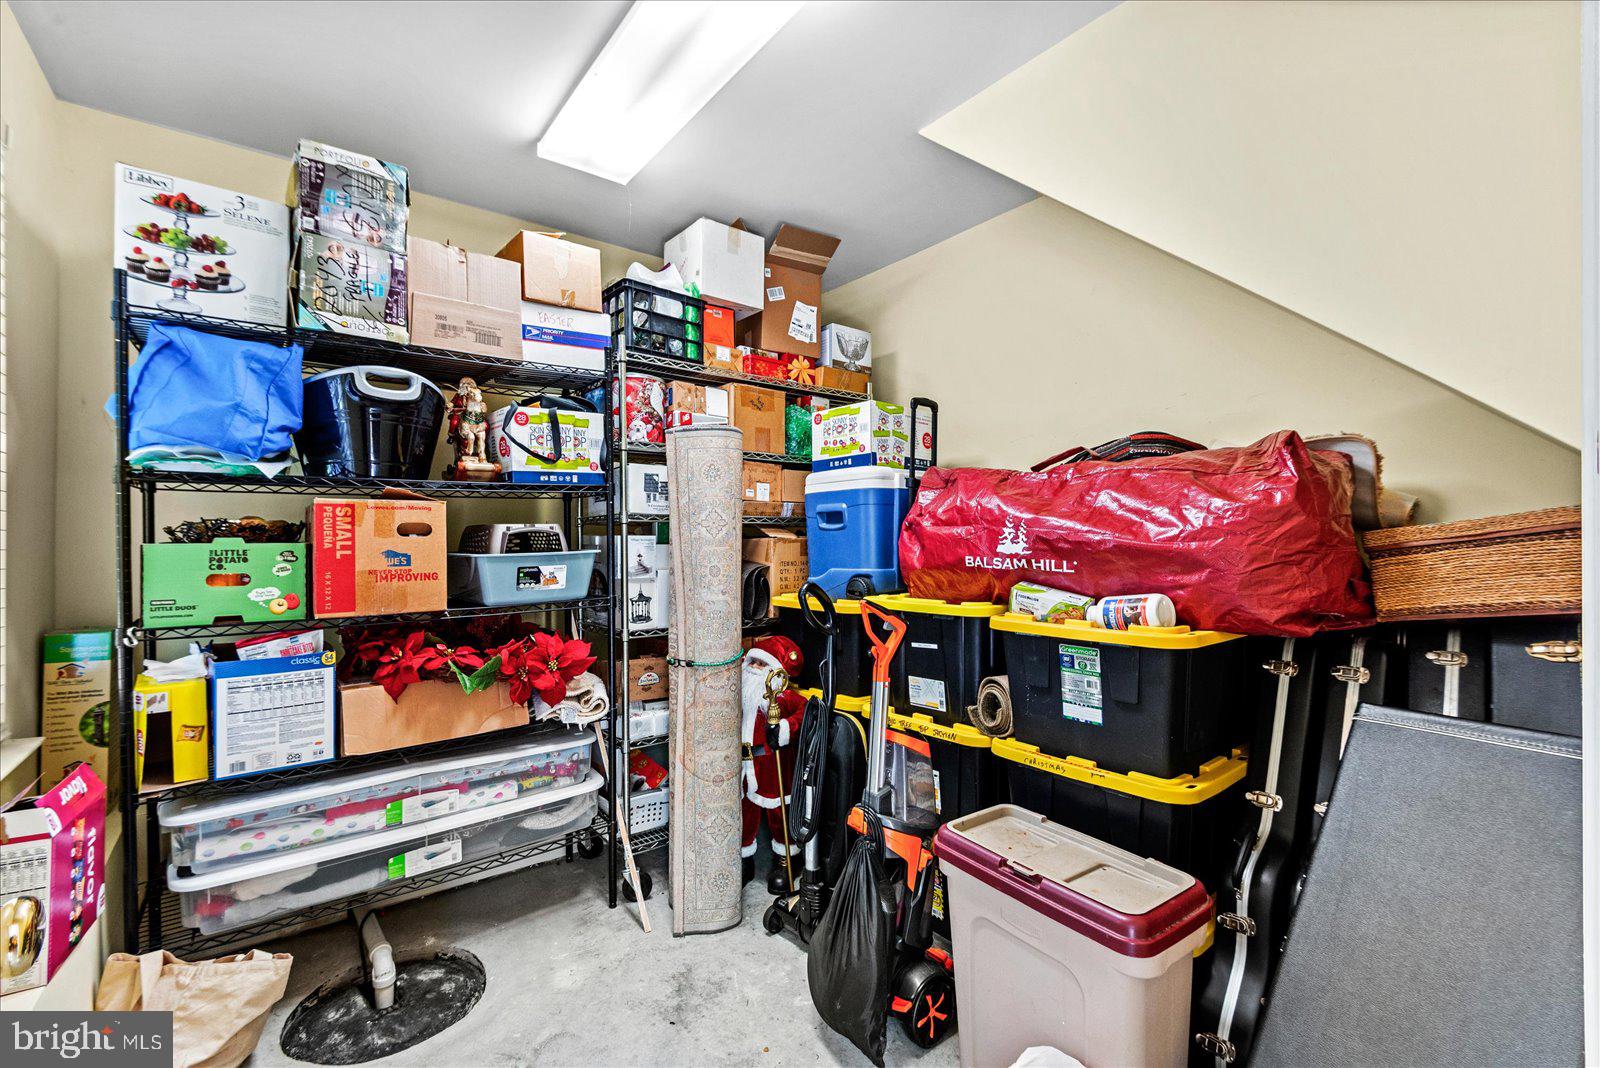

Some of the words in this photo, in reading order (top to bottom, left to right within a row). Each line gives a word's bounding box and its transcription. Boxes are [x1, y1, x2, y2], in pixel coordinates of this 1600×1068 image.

[127, 170, 169, 189] Libbey
[234, 195, 246, 211] 3
[223, 207, 272, 226] SELENE
[536, 311, 575, 328] EASTER
[542, 328, 565, 336] PRIORITY
[323, 505, 333, 549] PEQUEÑA
[335, 506, 353, 560] SMALL
[208, 556, 249, 565] POTATO
[214, 549, 248, 558] LITTLE
[208, 563, 227, 571] CO.
[964, 556, 1029, 571] BALSAM
[1031, 558, 1076, 574] HILL
[375, 571, 439, 583] IMPROVING
[1060, 645, 1100, 657] Greenmade
[290, 656, 321, 666] classic
[60, 775, 89, 806] flavor
[87, 827, 97, 904] flavor
